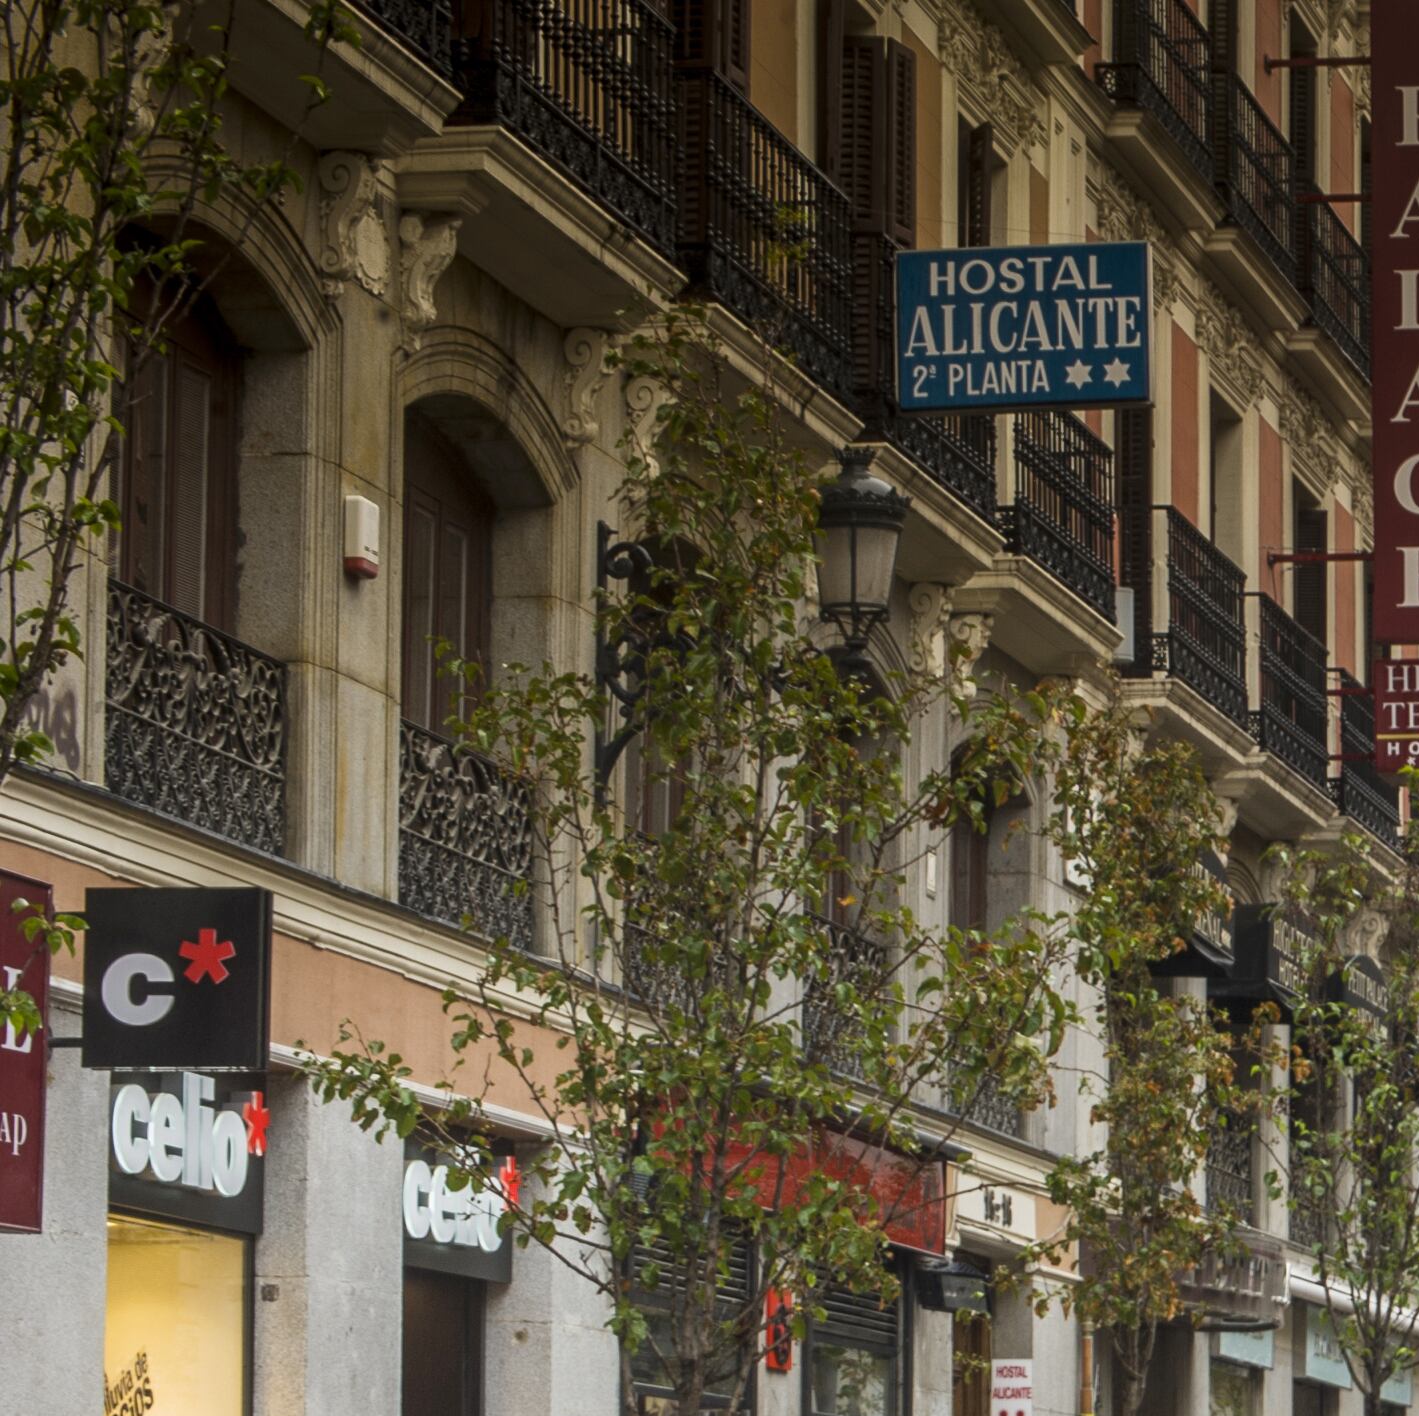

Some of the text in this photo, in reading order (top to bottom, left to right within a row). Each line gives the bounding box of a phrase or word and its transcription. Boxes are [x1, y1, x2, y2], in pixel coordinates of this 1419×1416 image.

[930, 255, 1112, 297] HOSTAL
[904, 296, 1141, 357] ALICANTE
[949, 359, 1050, 397] PLANTA
[996, 1366, 1028, 1378] HOSTAL
[992, 1387, 1032, 1399] ALICANTE
